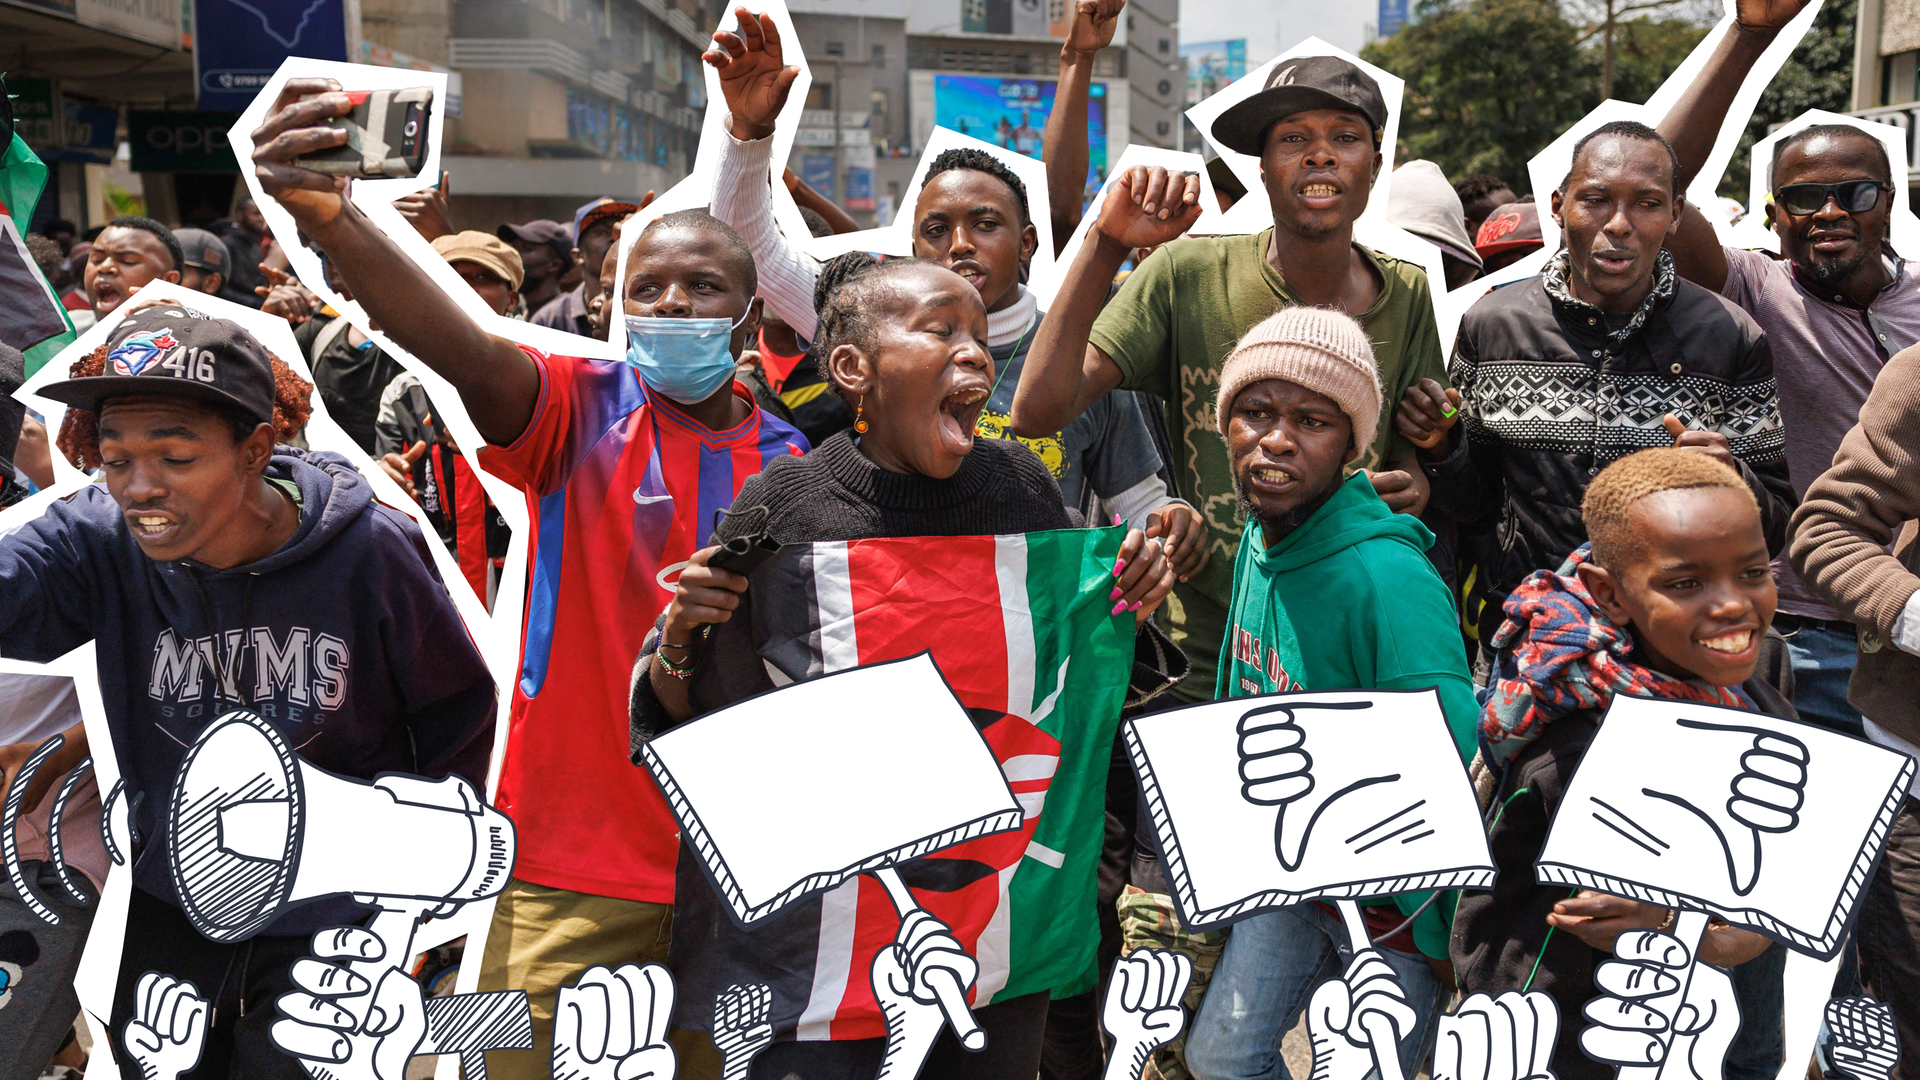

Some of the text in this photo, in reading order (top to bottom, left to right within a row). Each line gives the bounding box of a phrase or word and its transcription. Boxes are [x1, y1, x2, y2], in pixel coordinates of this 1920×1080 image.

[161, 345, 216, 383] 416
[1240, 677, 1259, 695] 1967
[160, 702, 327, 726] SQURES
